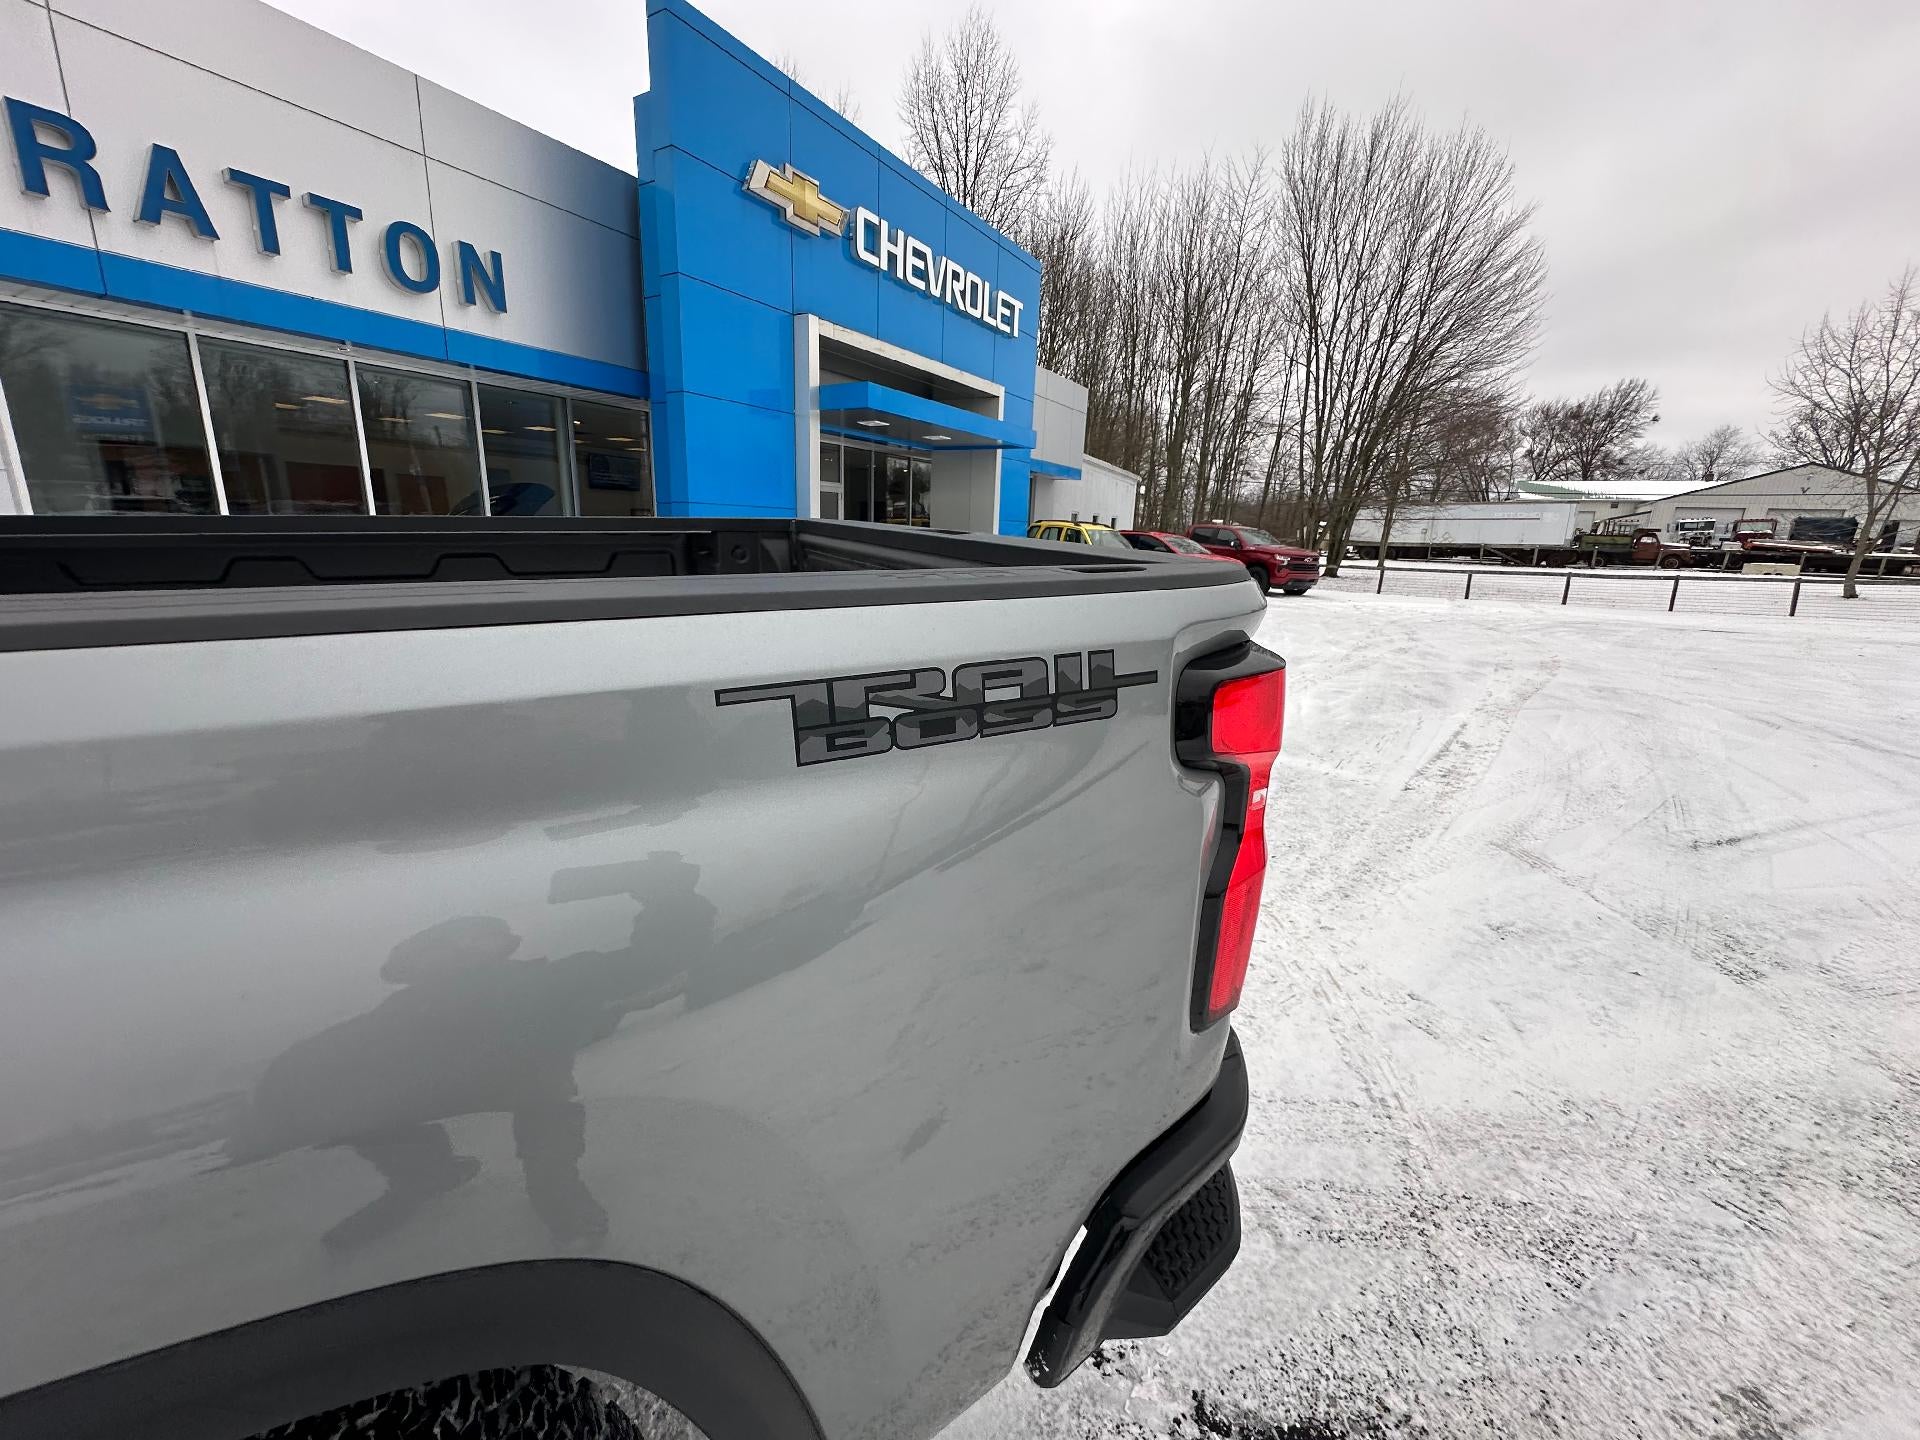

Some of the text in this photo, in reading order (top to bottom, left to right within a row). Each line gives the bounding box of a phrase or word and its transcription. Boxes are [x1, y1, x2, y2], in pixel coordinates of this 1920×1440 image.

[2, 95, 508, 314] RATTON
[855, 206, 1024, 338] CHEVROLET
[714, 649, 1158, 728] TRAIL
[796, 687, 1118, 767] BOSS
